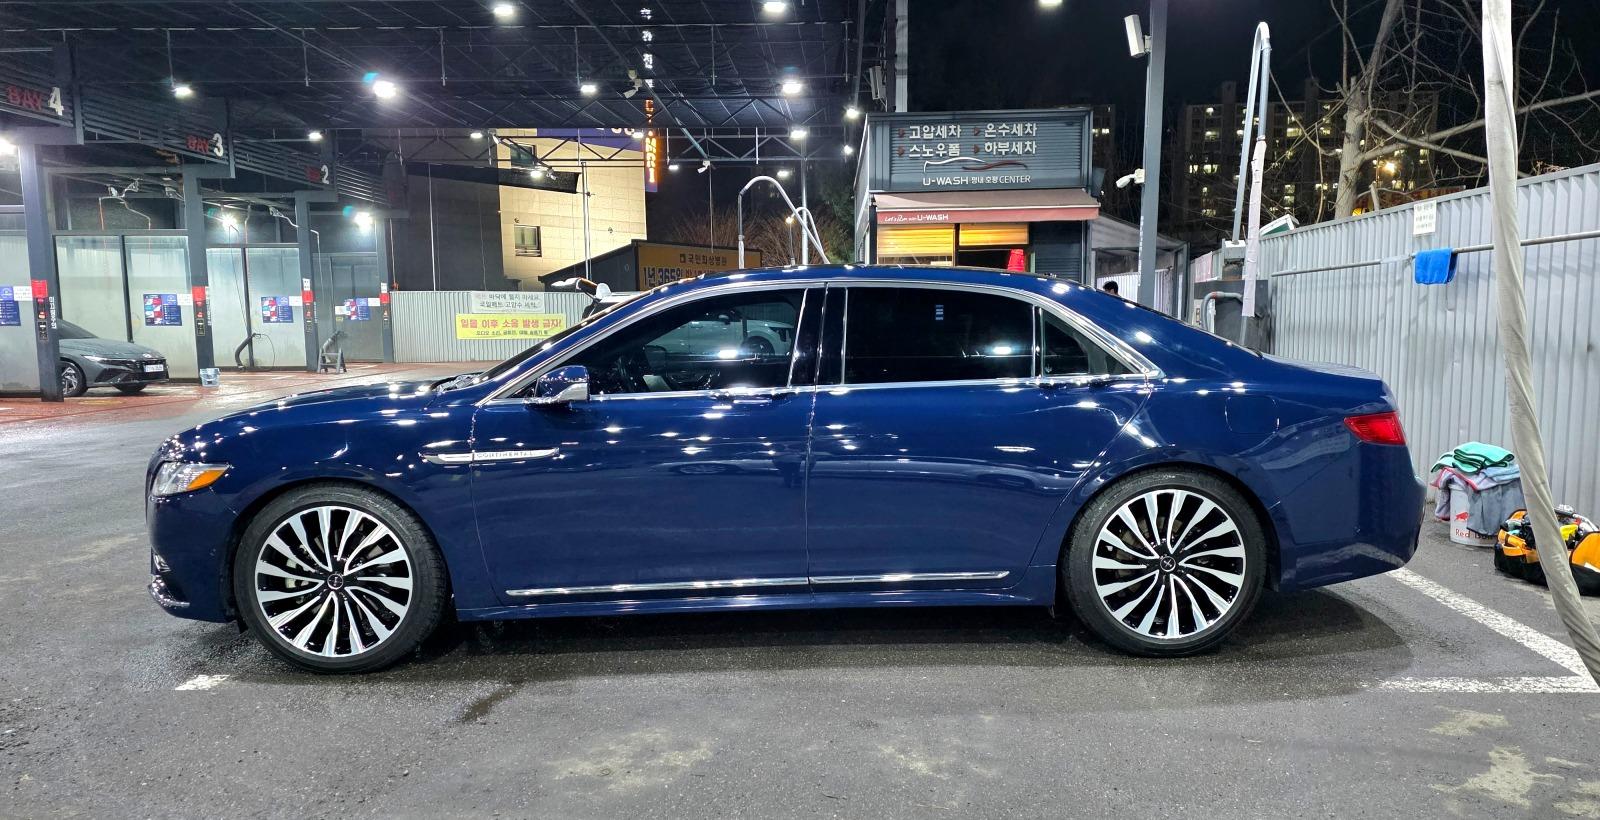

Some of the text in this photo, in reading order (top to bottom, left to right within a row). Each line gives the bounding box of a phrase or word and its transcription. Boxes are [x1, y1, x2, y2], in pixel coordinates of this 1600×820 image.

[48, 86, 65, 116] 4
[909, 124, 961, 139] 고압세차
[984, 122, 1037, 138] 온수세차
[210, 132, 224, 157] 3
[909, 142, 960, 157] 스노우폼
[984, 141, 1037, 155] 하부세차
[320, 164, 329, 184] 2
[922, 176, 969, 186] U-WASH
[999, 175, 1031, 184] CENTER
[481, 319, 498, 329] 이후
[1455, 528, 1470, 538] Red
